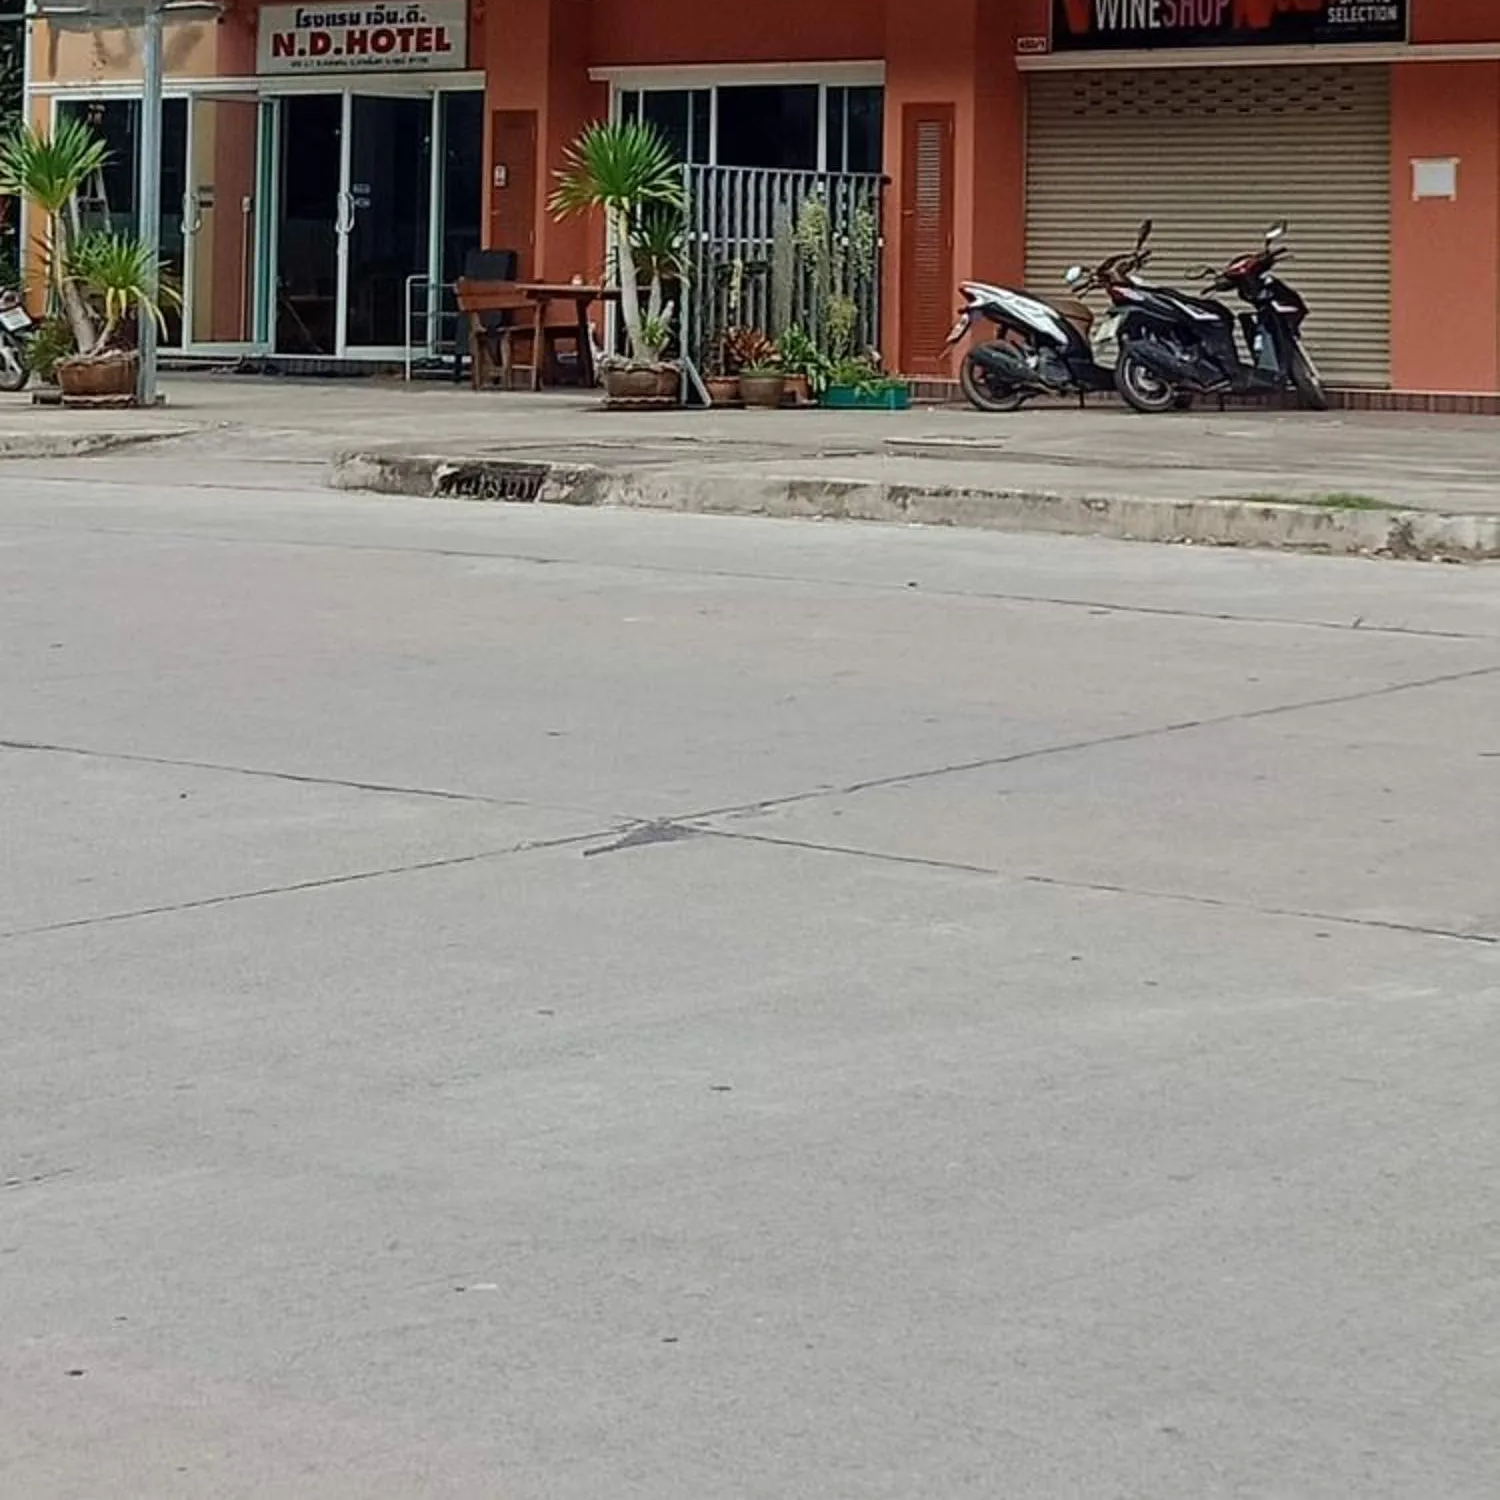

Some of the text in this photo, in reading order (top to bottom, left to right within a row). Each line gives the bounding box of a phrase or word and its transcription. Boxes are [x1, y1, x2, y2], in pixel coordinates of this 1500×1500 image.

[295, 7, 361, 29] โรงแรม
[1327, 4, 1398, 23] SELECTION
